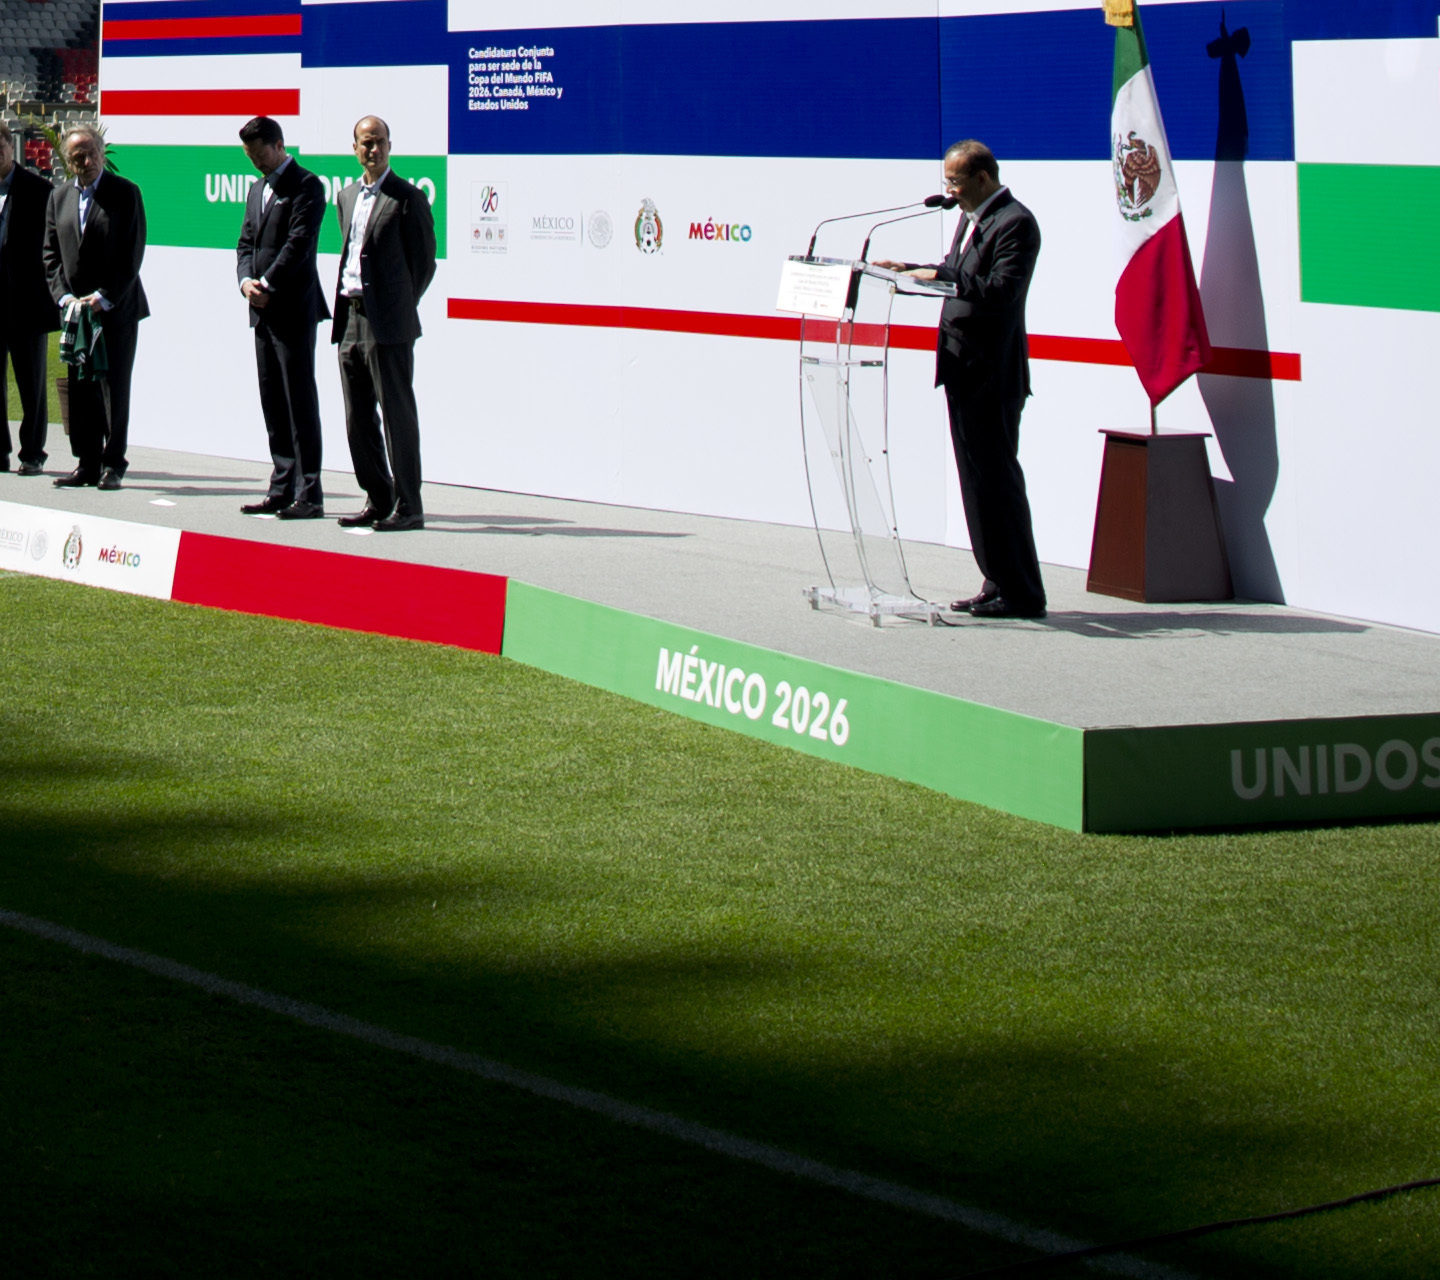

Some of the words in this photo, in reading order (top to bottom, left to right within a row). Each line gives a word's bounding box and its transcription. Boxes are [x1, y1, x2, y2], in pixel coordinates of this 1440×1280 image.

[468, 47, 517, 59] Candidatura
[517, 45, 555, 60] Conjunta
[468, 62, 487, 74] para
[487, 61, 501, 71] ser
[501, 59, 521, 71] sede
[521, 59, 533, 71] de
[533, 59, 542, 70] la
[468, 73, 490, 87] Copa
[490, 72, 504, 84] del
[504, 72, 534, 84] Mundo
[534, 71, 554, 83] FIFA
[468, 86, 492, 98] 2026.
[492, 85, 526, 98] Canadá,
[526, 85, 557, 97] México
[556, 86, 563, 99] y
[468, 98, 500, 111] Estados
[499, 97, 530, 111] Unidos
[531, 213, 575, 230] MÉXICO
[655, 644, 768, 721] MÉXICO
[772, 680, 850, 747] 2026
